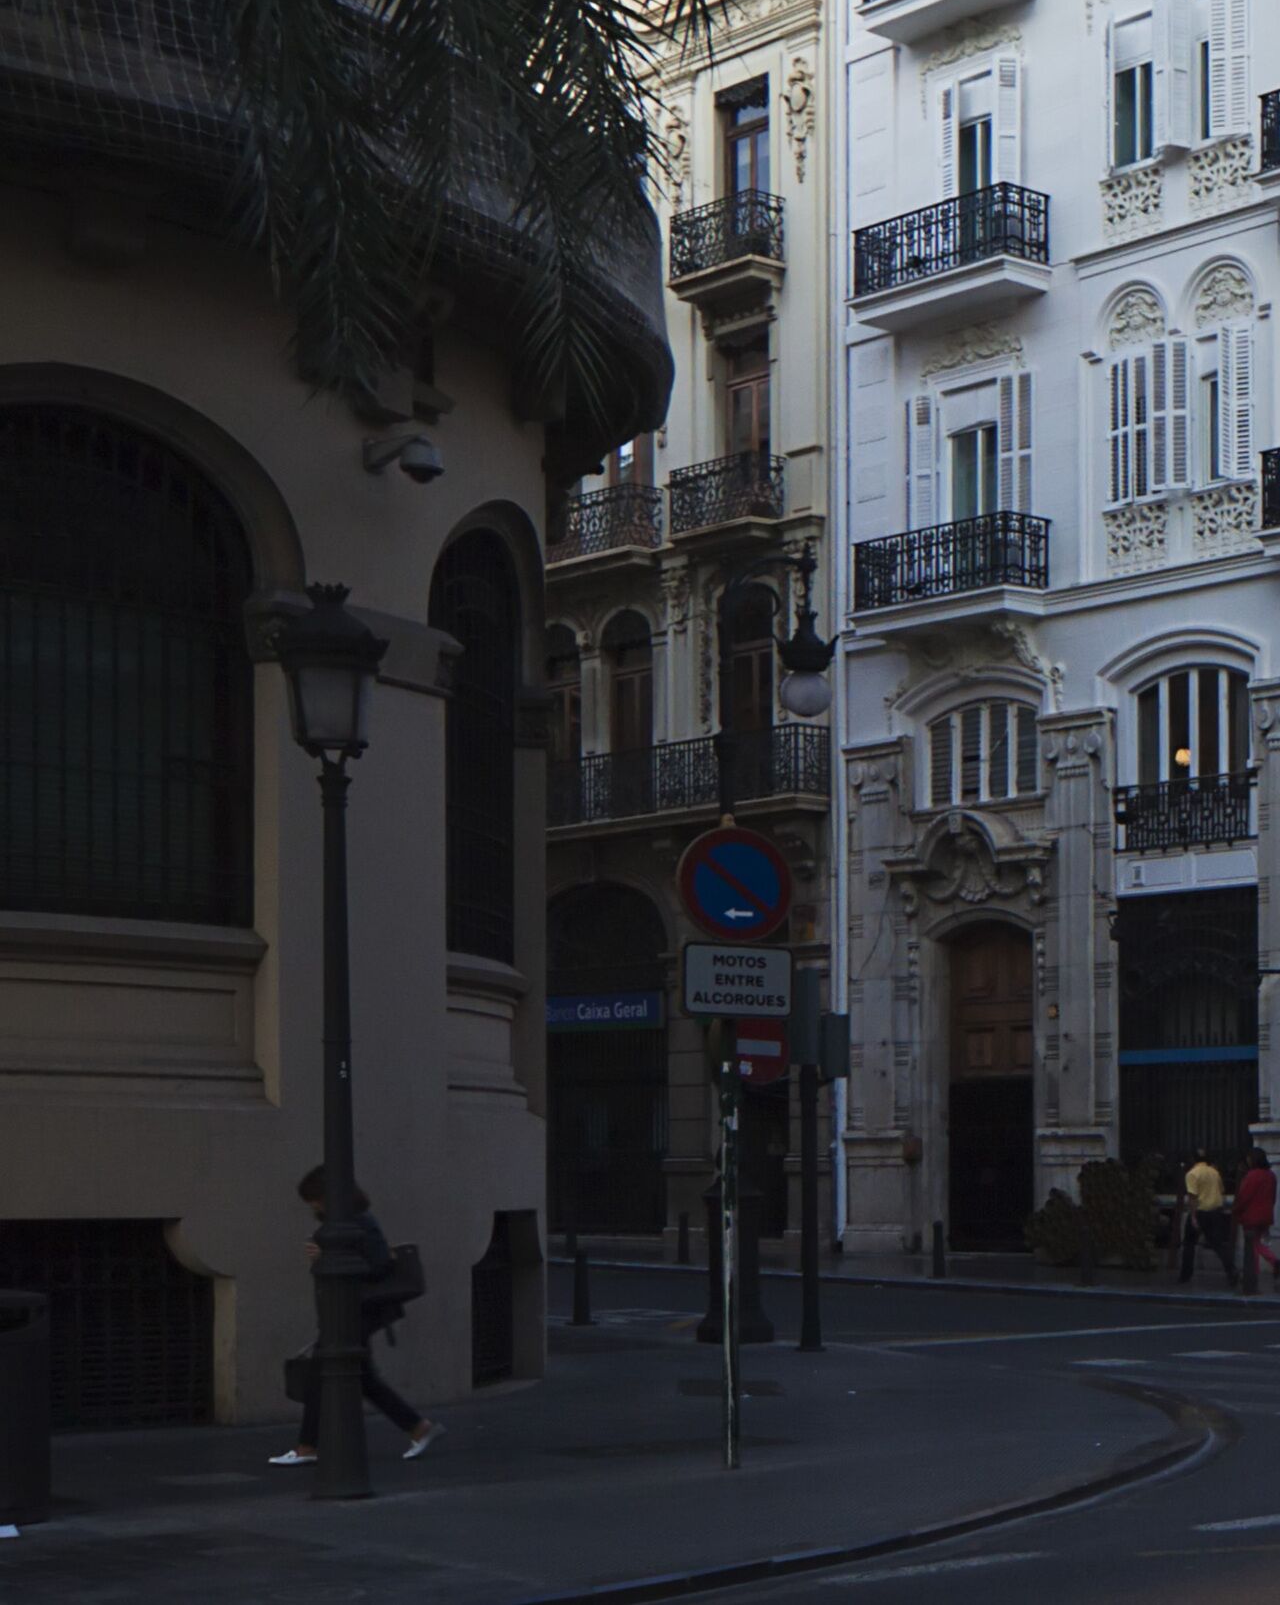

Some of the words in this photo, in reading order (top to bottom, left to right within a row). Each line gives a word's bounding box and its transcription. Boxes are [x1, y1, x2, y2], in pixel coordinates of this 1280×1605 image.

[712, 954, 767, 969] MOTOS
[714, 973, 765, 988] ENTRE
[692, 991, 786, 1007] ALCORQUES
[576, 1002, 611, 1020] Caixa
[613, 999, 648, 1019] Geral
